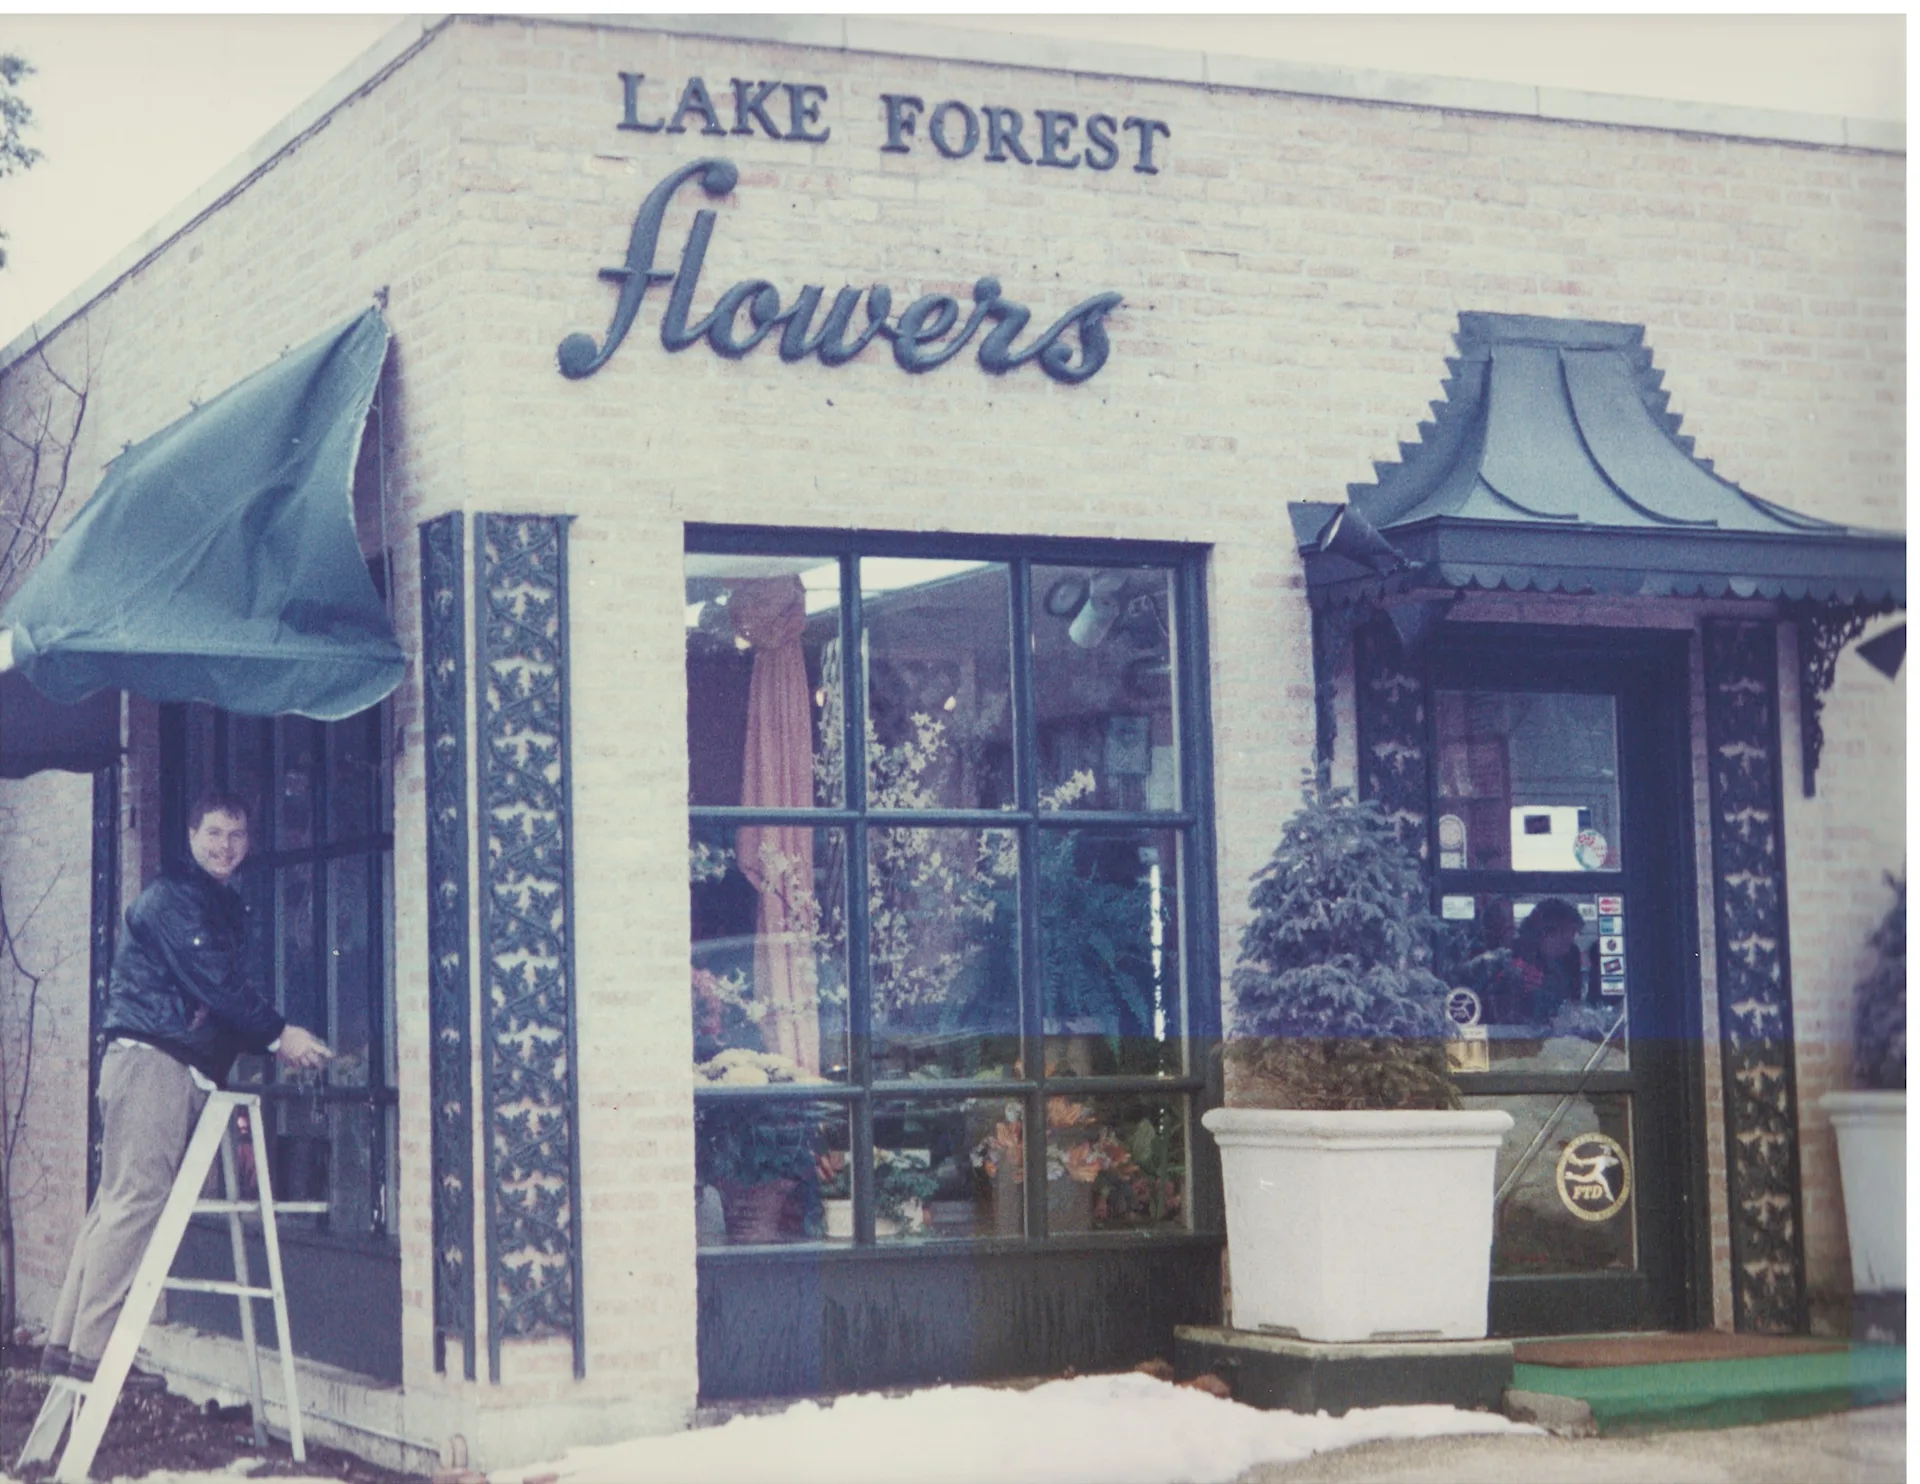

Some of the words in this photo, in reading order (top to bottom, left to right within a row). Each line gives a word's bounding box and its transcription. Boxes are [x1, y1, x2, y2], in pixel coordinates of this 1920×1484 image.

[616, 71, 831, 143] LAKE
[879, 93, 1171, 175] FOREST
[556, 158, 1124, 385] flowers
[1572, 1185, 1604, 1200] FTD
